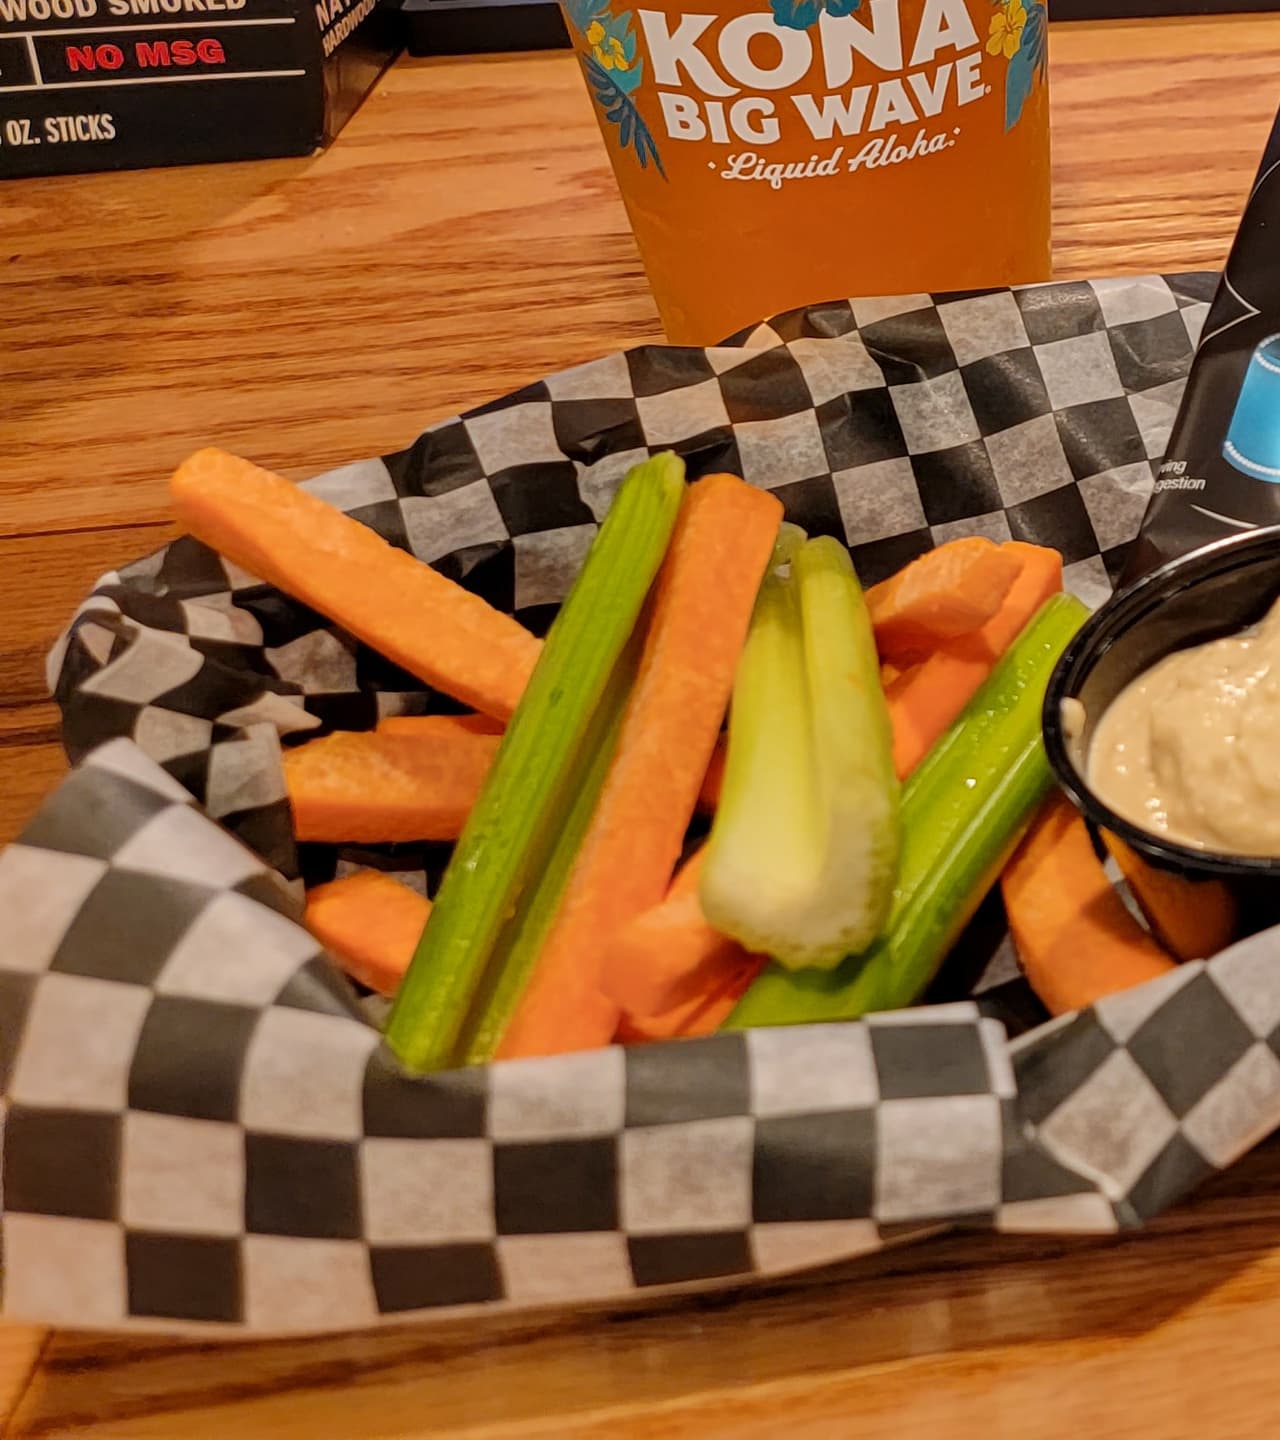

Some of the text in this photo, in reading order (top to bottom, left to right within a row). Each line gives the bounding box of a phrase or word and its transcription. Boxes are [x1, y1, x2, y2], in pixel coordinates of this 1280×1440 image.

[66, 38, 227, 73] NO MSG
[6, 113, 117, 147] OZ. STICKS
[656, 90, 782, 145] BIG
[720, 146, 844, 190] Liquid
